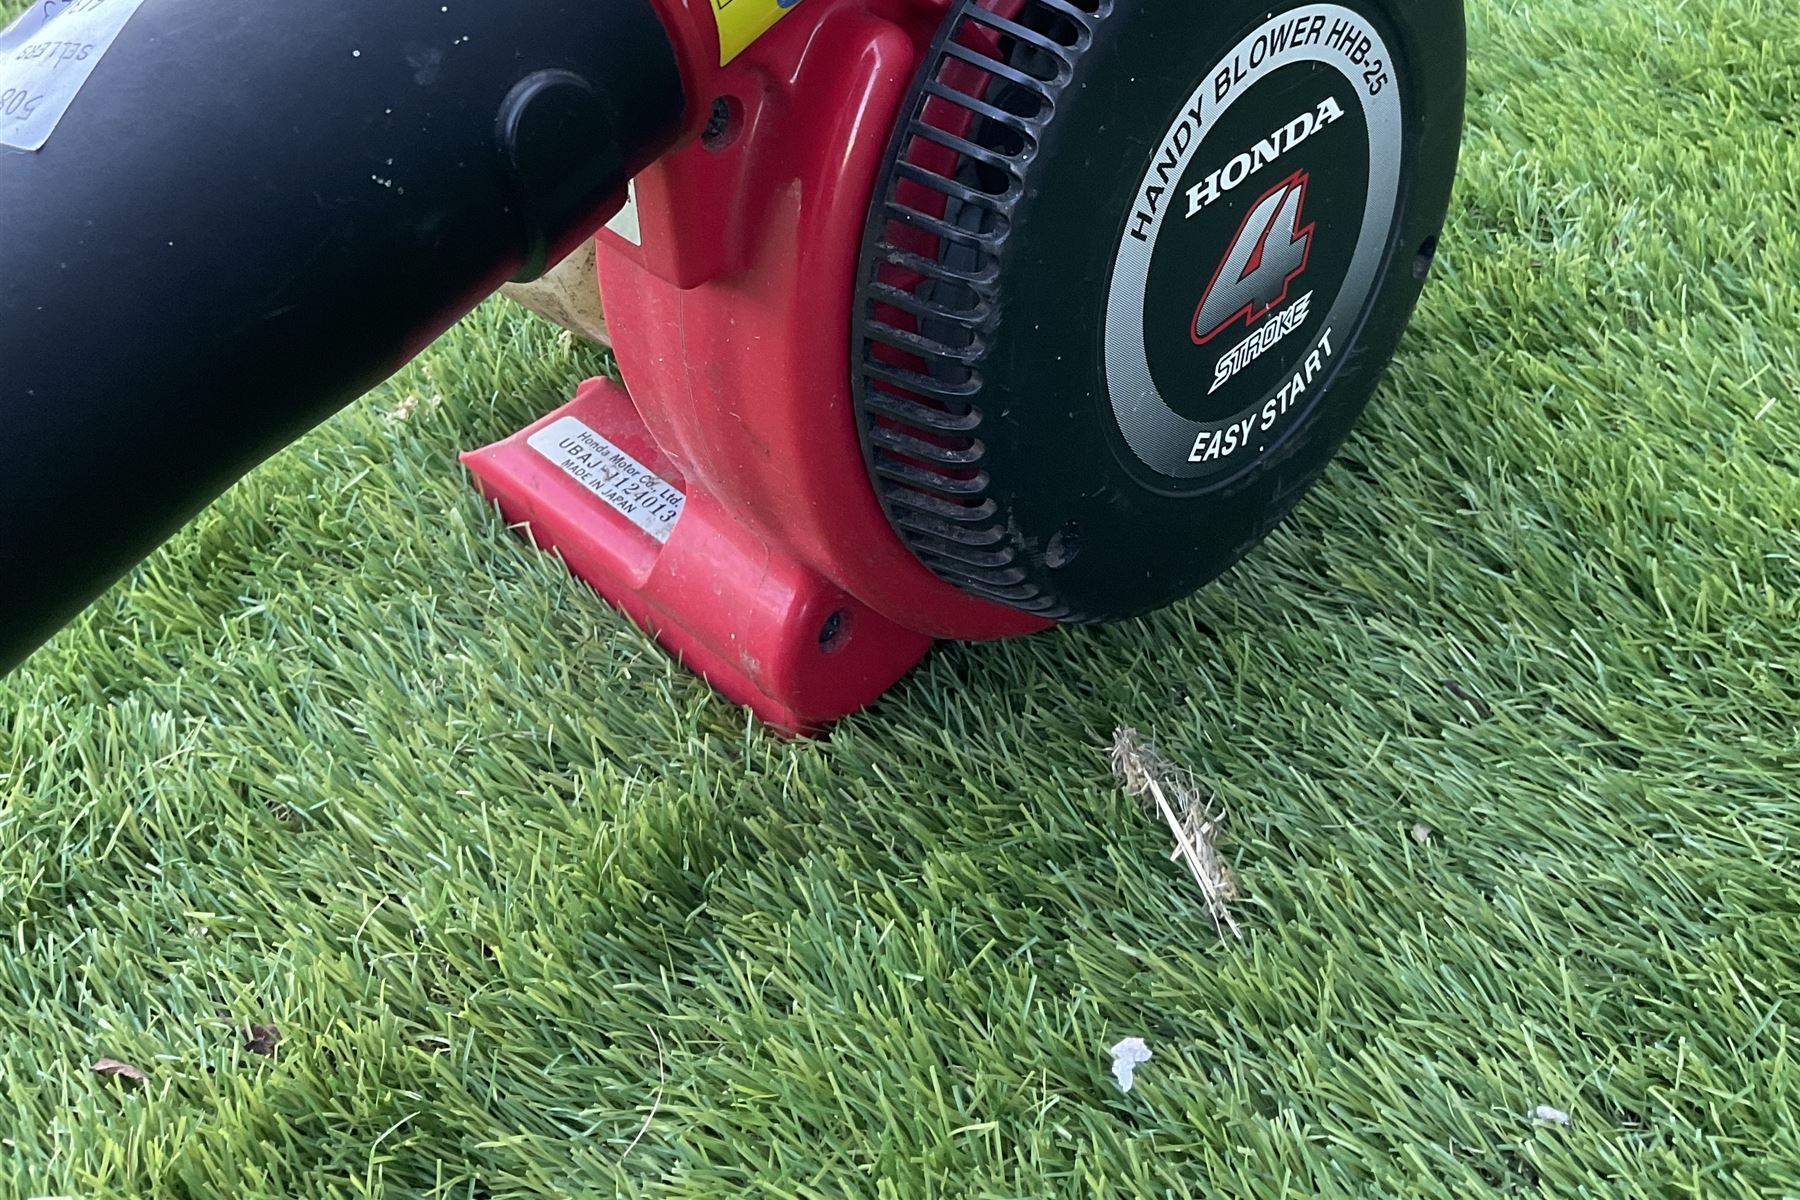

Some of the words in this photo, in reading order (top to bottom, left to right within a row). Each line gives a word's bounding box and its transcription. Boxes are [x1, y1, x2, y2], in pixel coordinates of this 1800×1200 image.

[1131, 94, 1204, 243] HANDY
[1214, 15, 1326, 105] BLOWER
[1325, 18, 1388, 96] HHB-25
[1185, 96, 1345, 219] HONDA
[1191, 168, 1316, 345] 4
[1187, 413, 1257, 464] EASY
[1260, 327, 1334, 433] START
[1207, 290, 1314, 396] STROKE
[561, 458, 593, 481] MADE
[589, 477, 604, 491] IN
[601, 488, 637, 514] JAPAN
[577, 431, 611, 457] Honda
[609, 453, 641, 477] Motor
[660, 488, 684, 508] Ltd.
